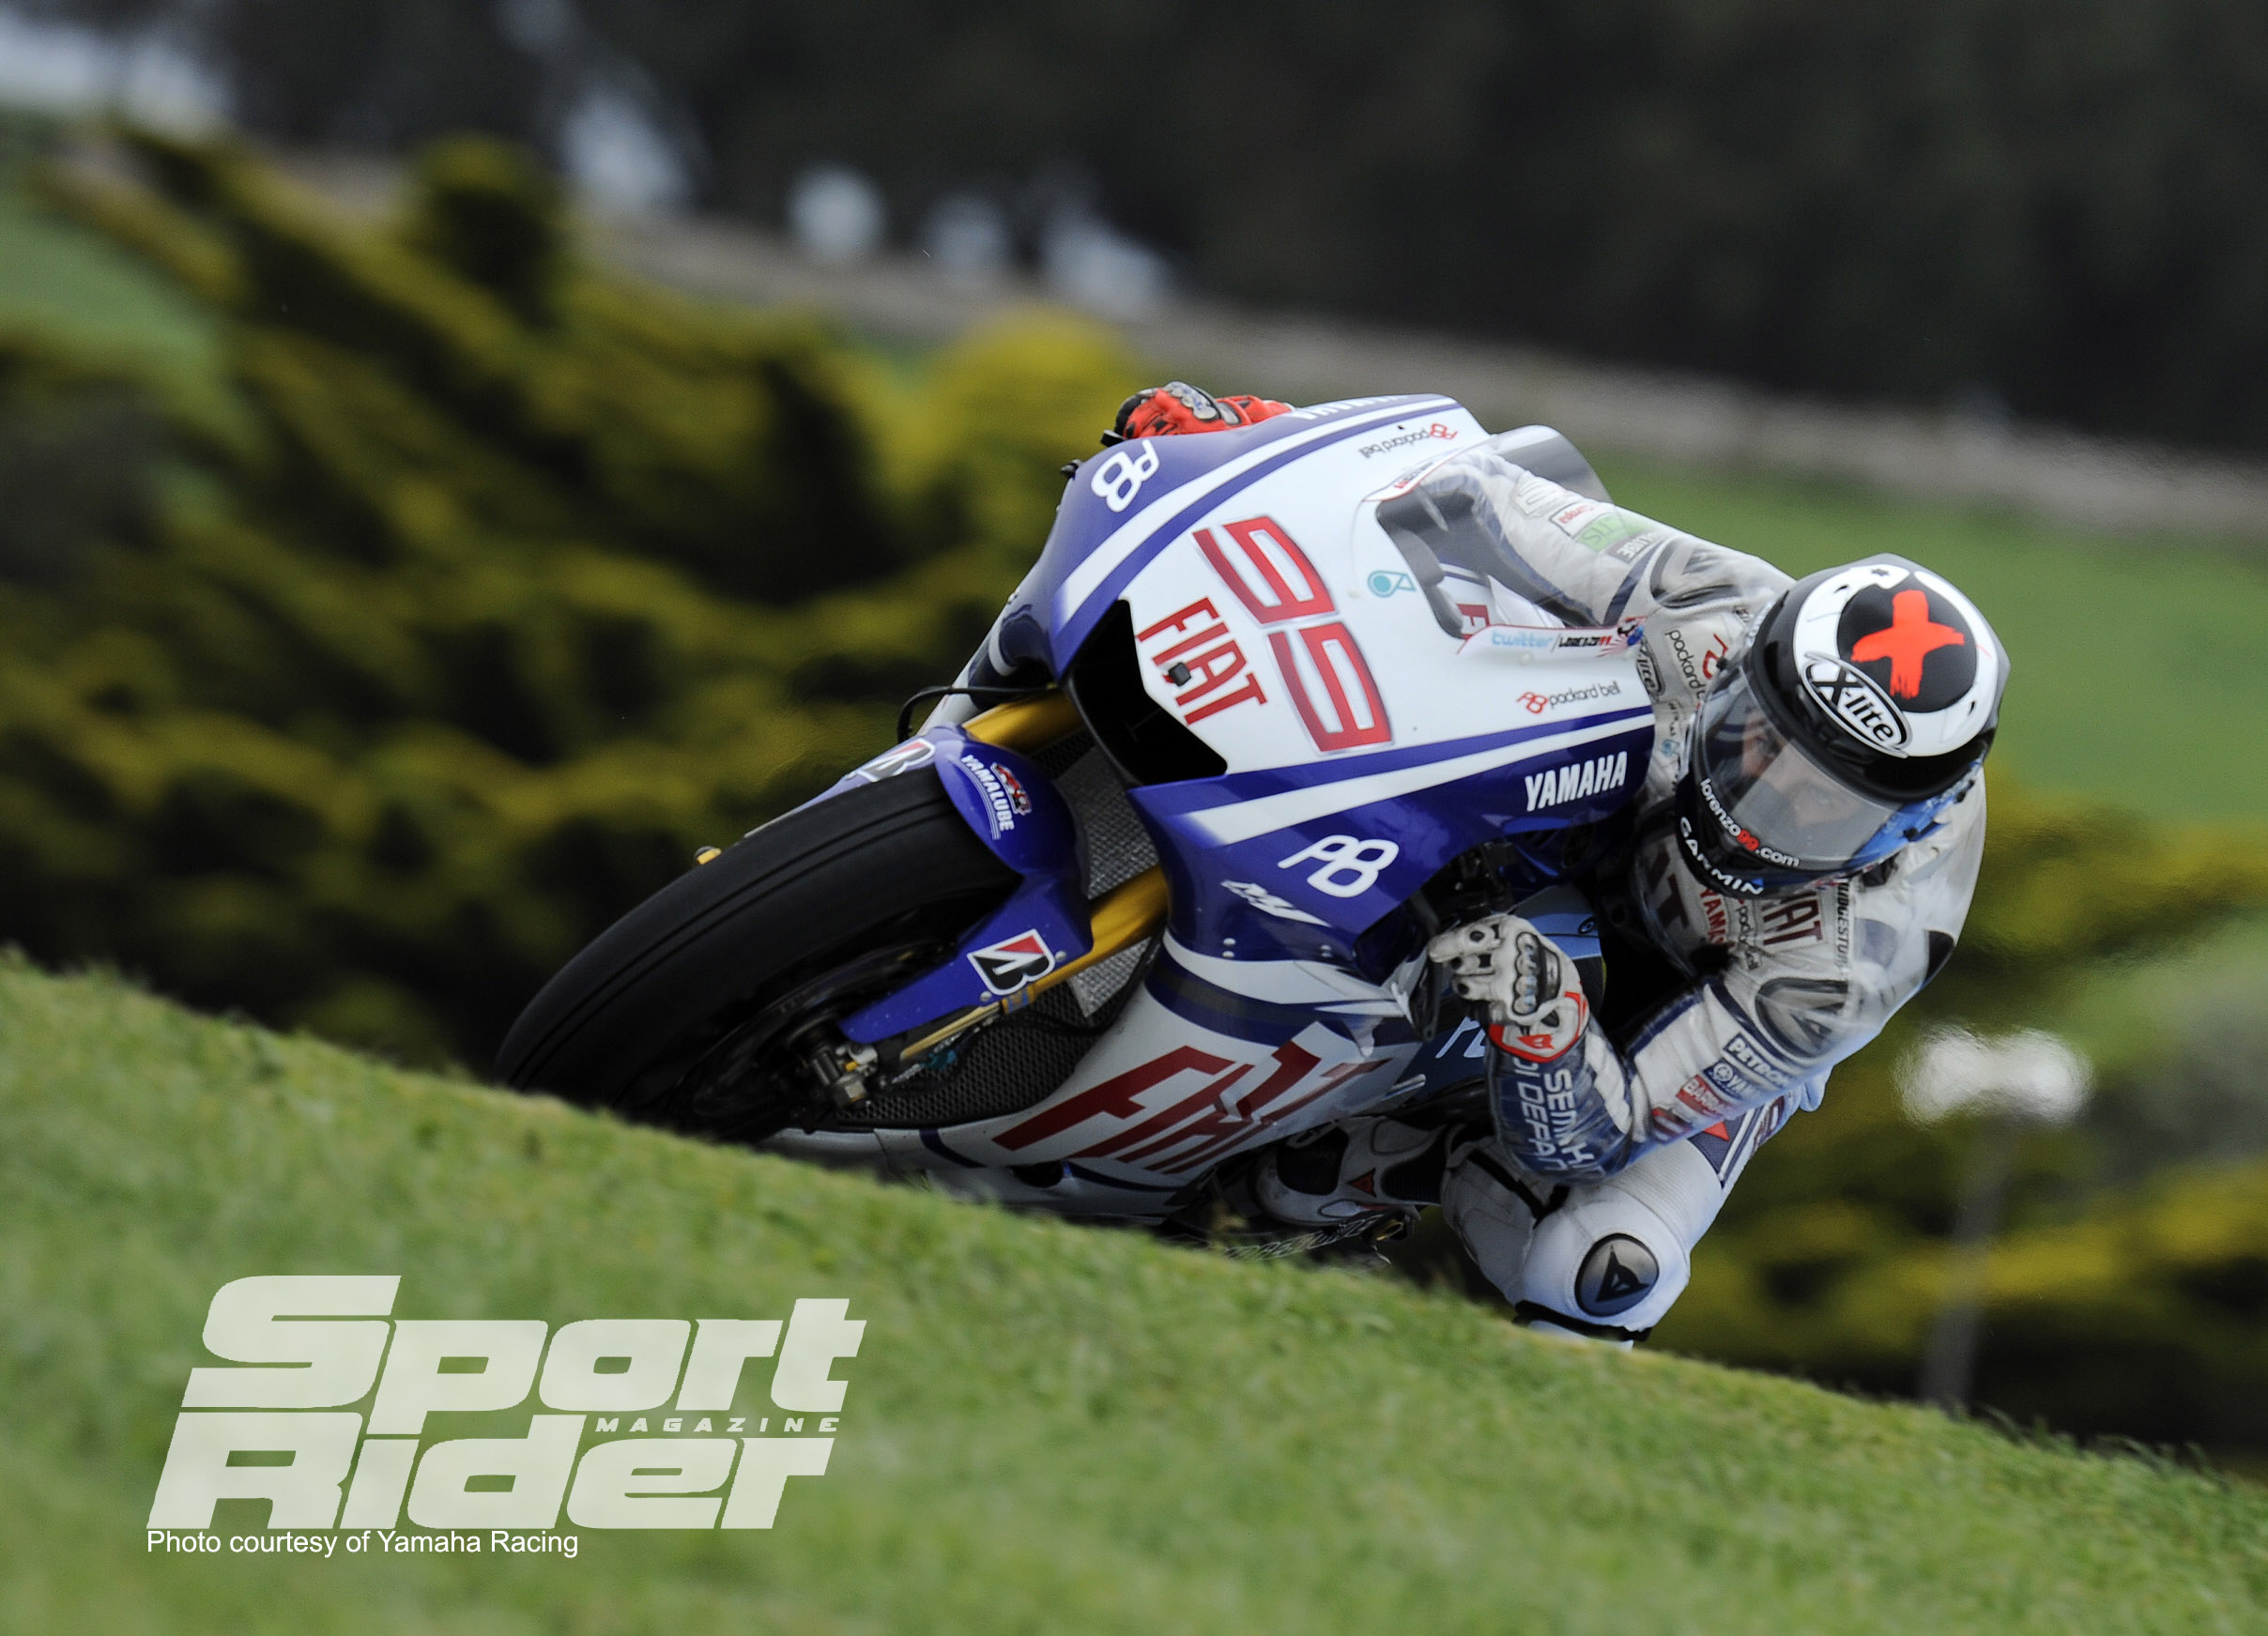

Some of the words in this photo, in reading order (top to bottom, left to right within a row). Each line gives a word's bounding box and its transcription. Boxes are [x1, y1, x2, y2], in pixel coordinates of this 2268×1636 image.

[1135, 597, 1267, 726] FIAT
[1491, 630, 1553, 649] twitter
[1664, 629, 1708, 694] packard
[1549, 684, 1599, 709] packard
[1807, 665, 1894, 742] X-lite
[961, 754, 1015, 832] YAMALUBE
[1523, 751, 1629, 812] YAMAHA
[1679, 816, 1765, 895] GARMIN
[1700, 778, 1800, 868] lorenzo99.com
